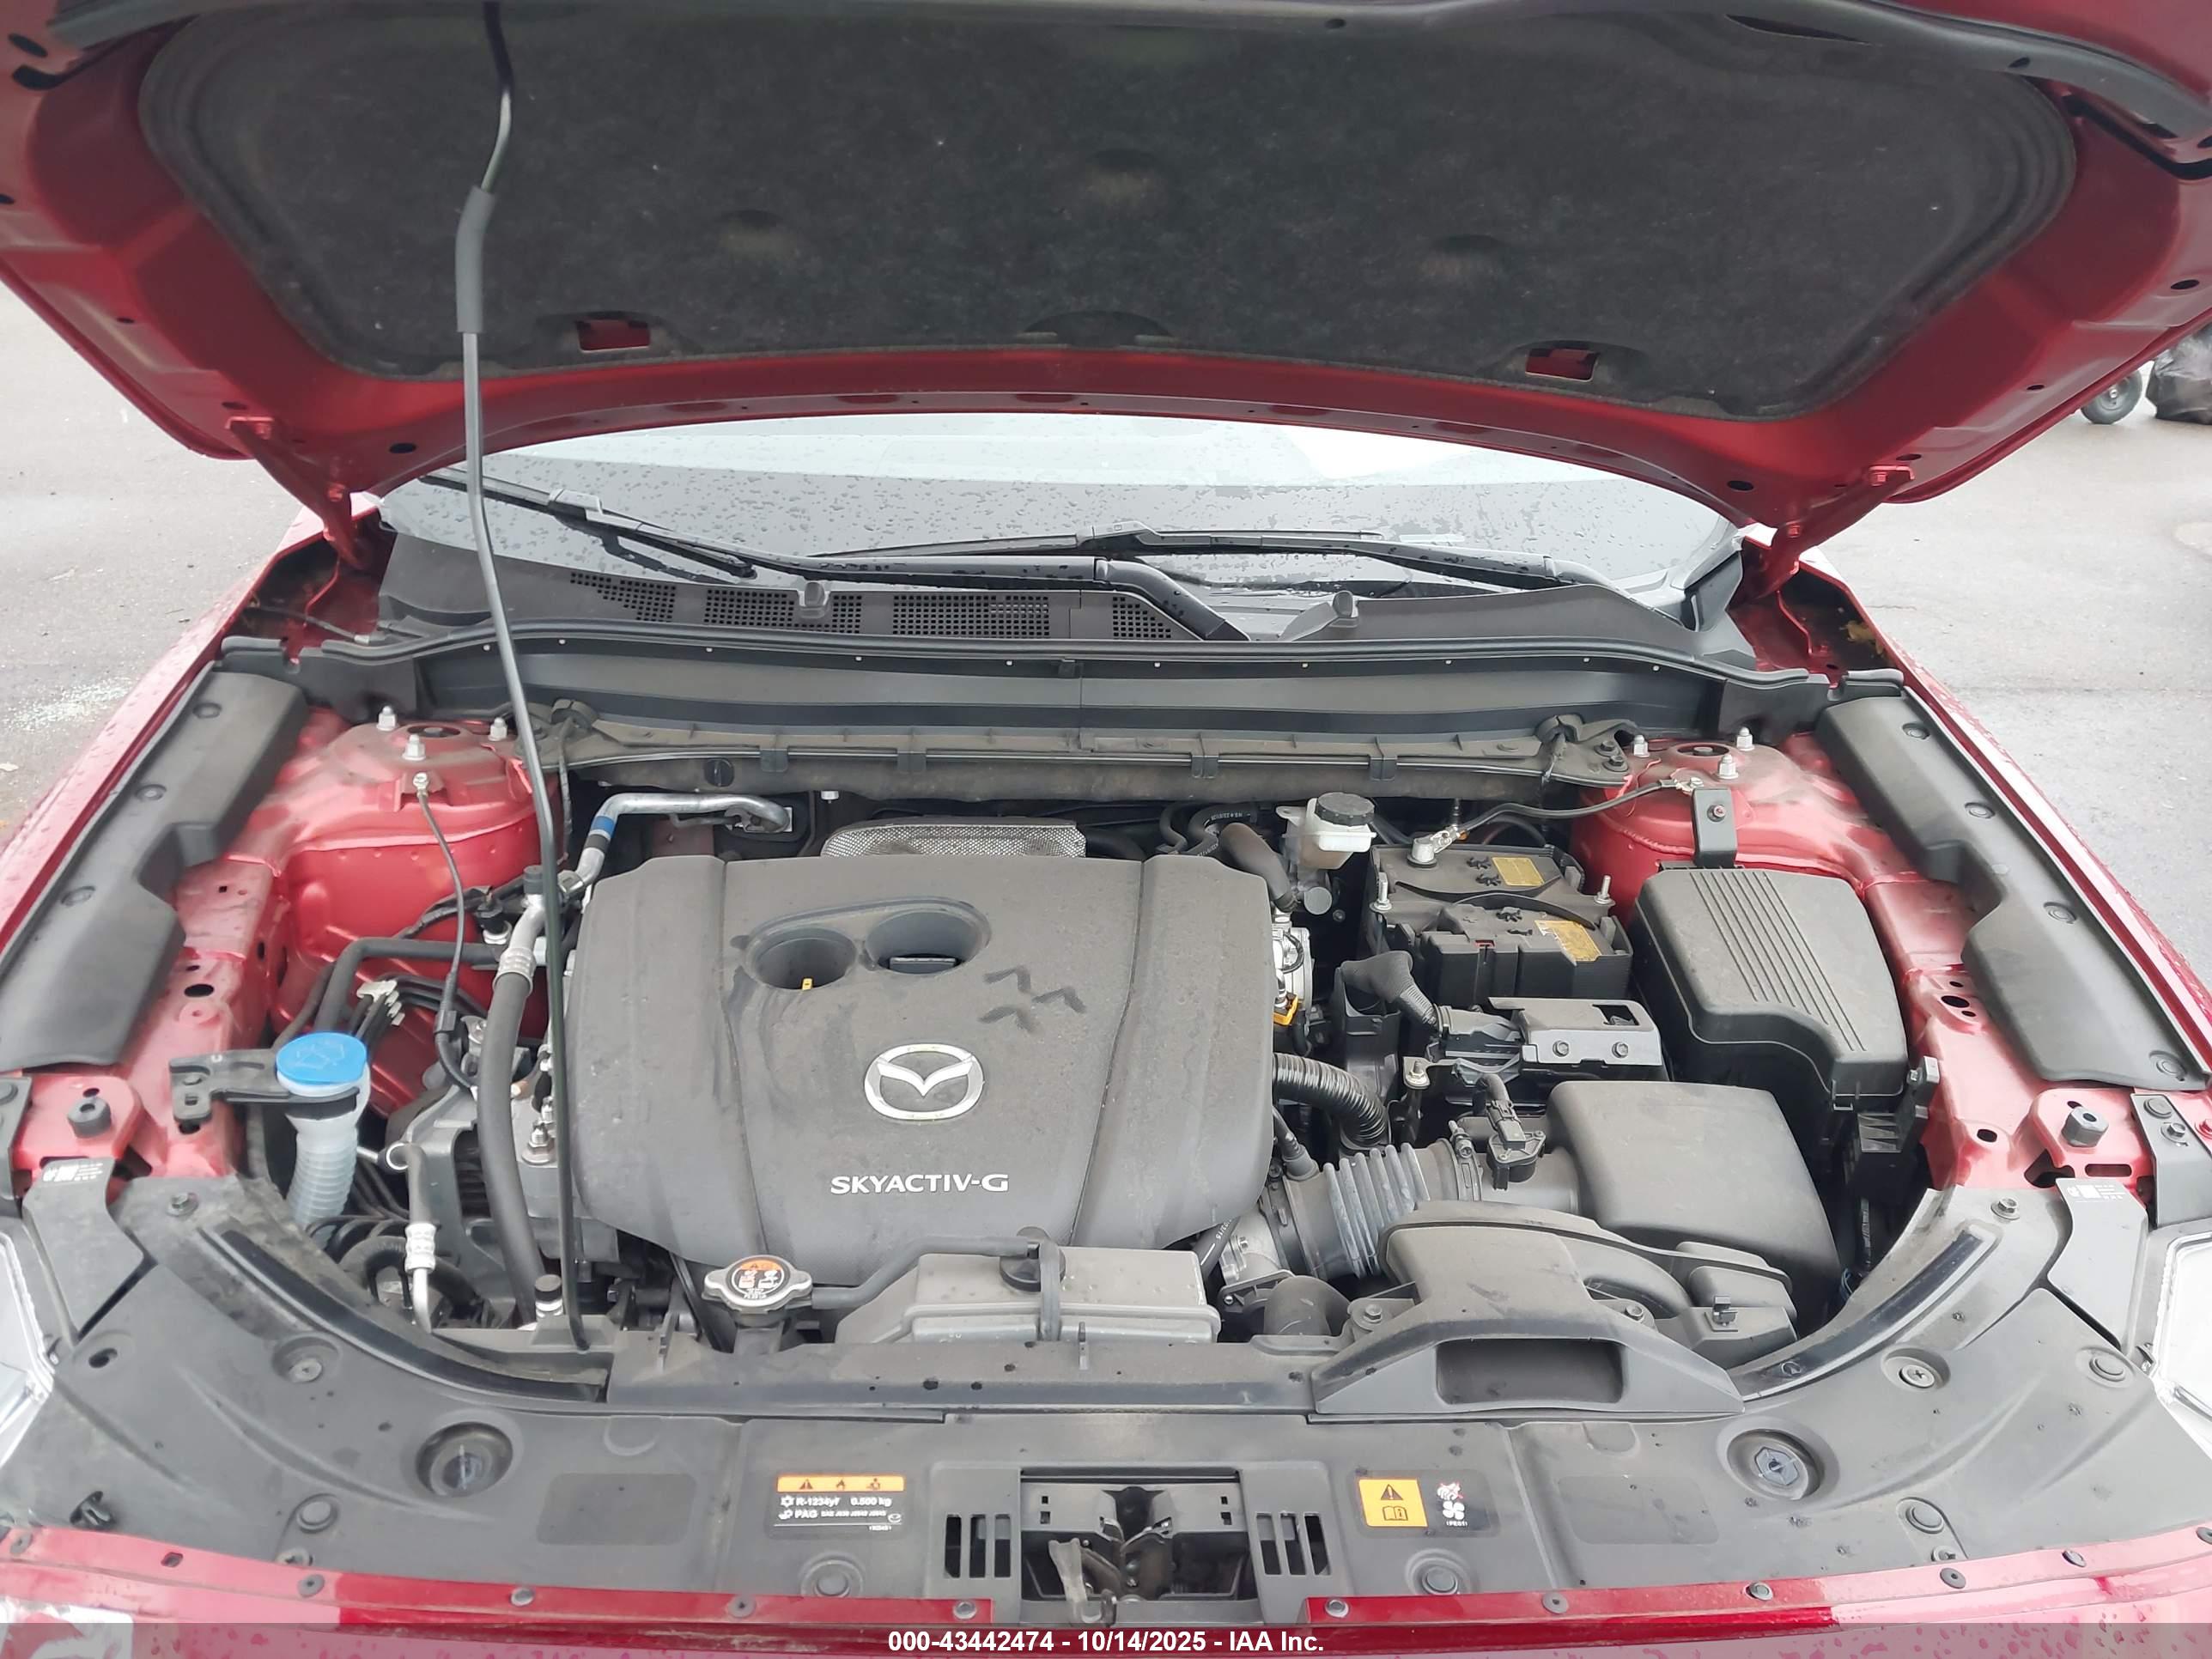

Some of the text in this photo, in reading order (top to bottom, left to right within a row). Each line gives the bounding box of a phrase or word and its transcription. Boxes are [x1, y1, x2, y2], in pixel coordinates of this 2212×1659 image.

[830, 1173, 1009, 1194] SKYACTIV-G
[796, 1497, 891, 1507] R-1234yf 0.500 kg
[794, 1509, 818, 1519] PAG
